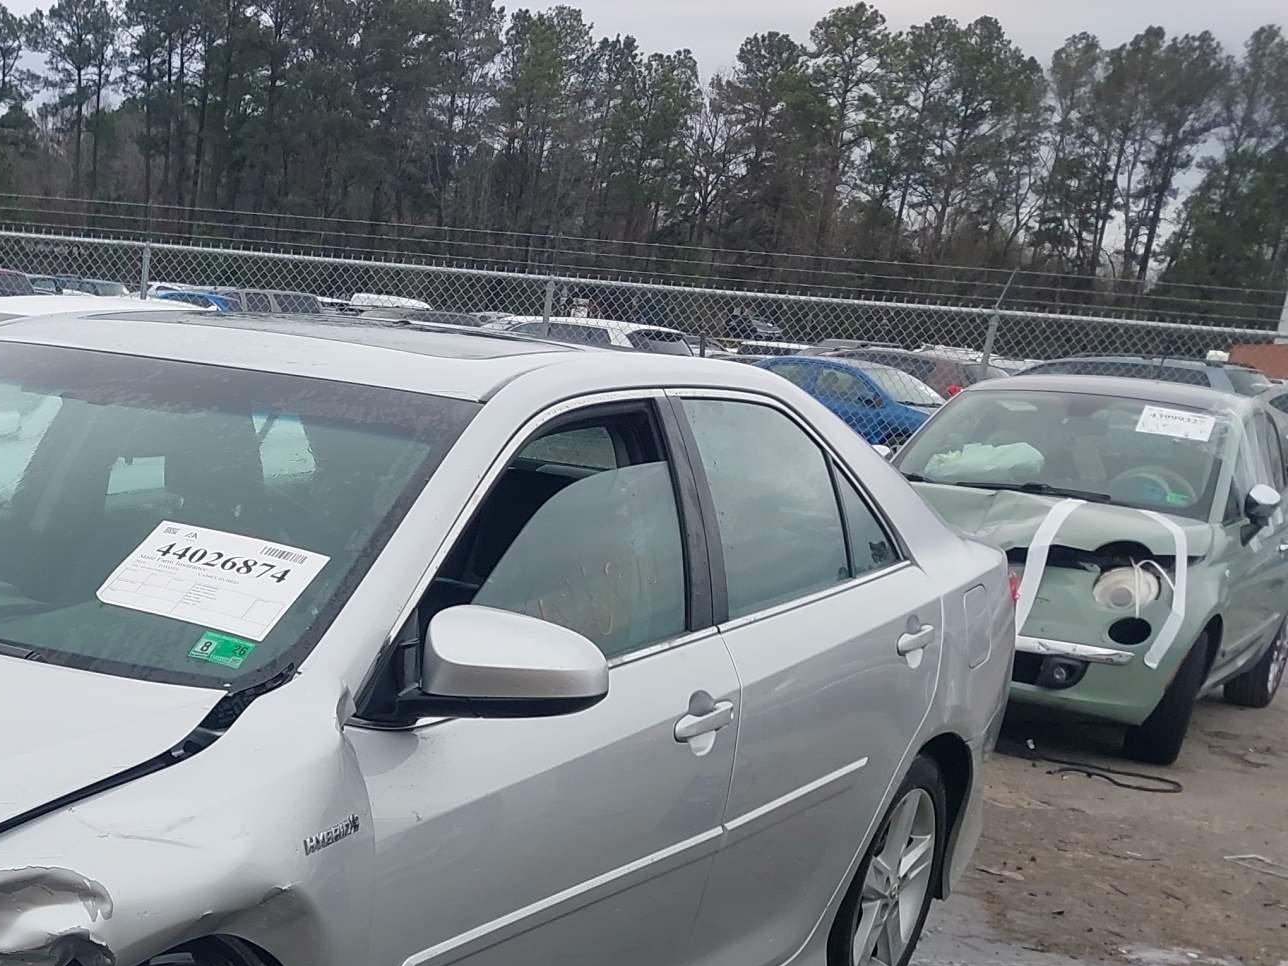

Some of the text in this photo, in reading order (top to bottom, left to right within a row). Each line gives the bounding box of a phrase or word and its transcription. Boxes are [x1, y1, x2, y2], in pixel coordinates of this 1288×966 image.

[156, 542, 292, 584] 44026874
[200, 640, 249, 656] 8 26
